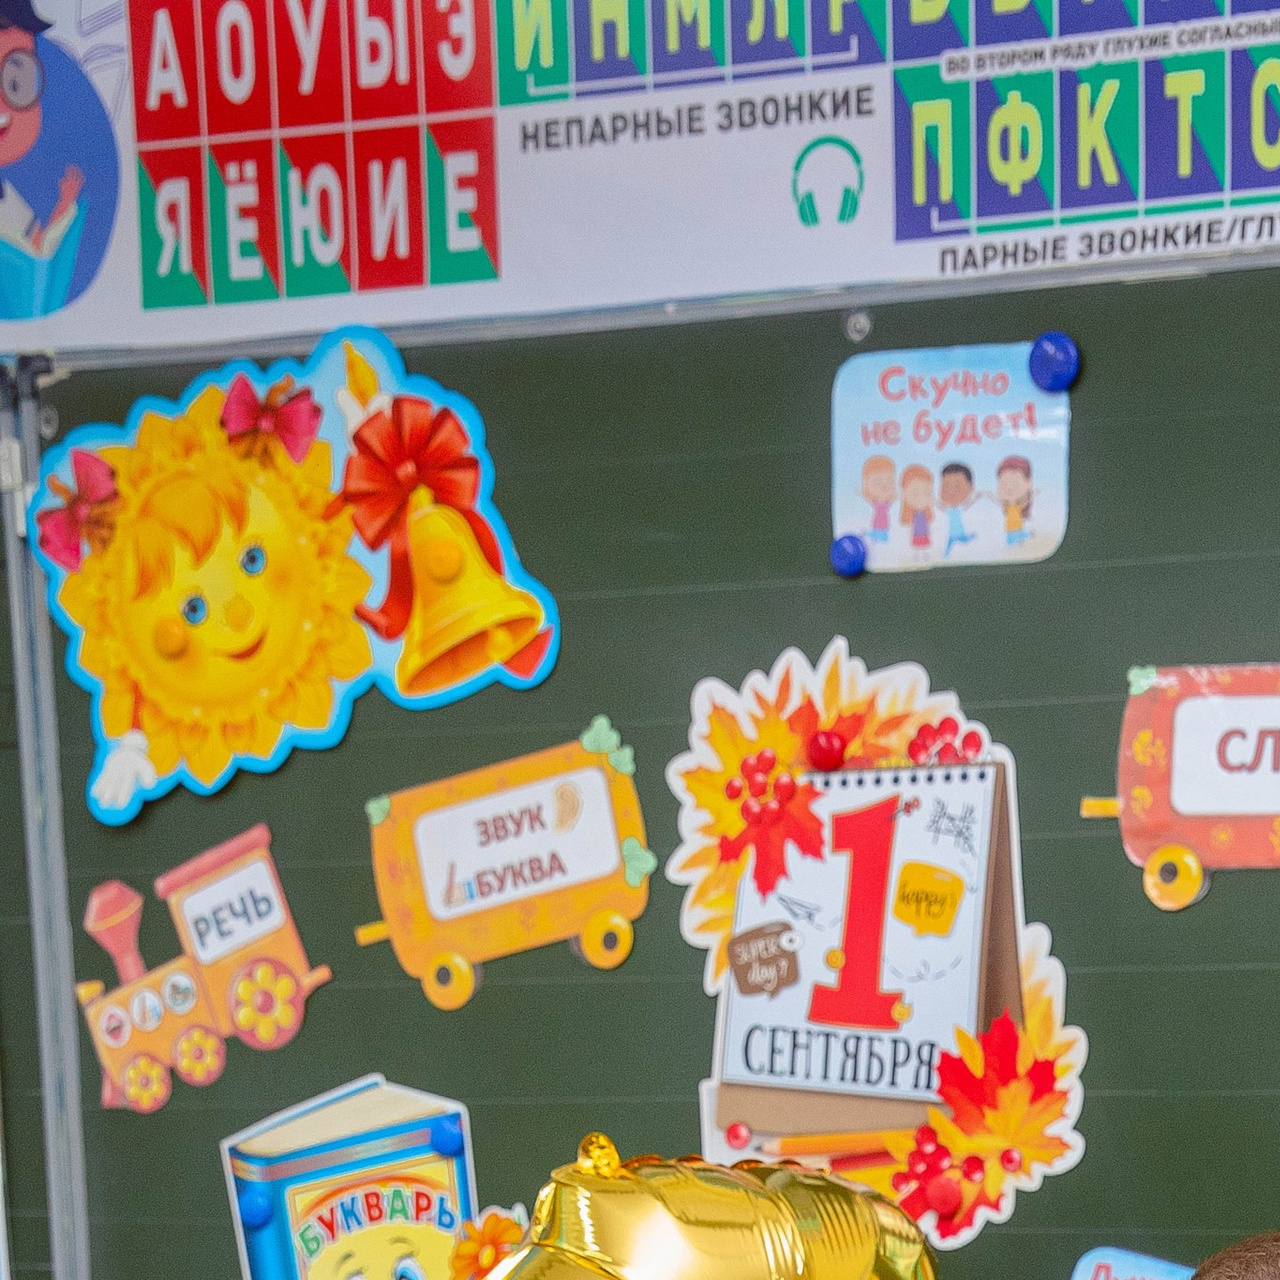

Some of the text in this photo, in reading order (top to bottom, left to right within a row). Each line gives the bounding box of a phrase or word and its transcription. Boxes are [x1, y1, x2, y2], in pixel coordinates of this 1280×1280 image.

[146, 8, 188, 111] А
[215, 2, 256, 105] О
[975, 47, 1045, 71] ВТОРОМ
[520, 84, 876, 153] НЕПАРНЫЕ ЗВОНКИЕ
[911, 98, 953, 205] П
[987, 90, 1043, 196] Ф
[1076, 78, 1120, 189] К
[1163, 69, 1206, 178] Т
[154, 150, 482, 282] Я Ё Ю И Е
[940, 234, 1068, 276] ПАРНЫЕ
[878, 365, 1009, 408] Скучно
[861, 401, 1037, 450] не будет!
[475, 806, 546, 848] ЗВУК
[475, 853, 568, 900] БУКВА
[193, 892, 274, 950] РЕЧЬ
[807, 793, 903, 1031] 1
[743, 1023, 940, 1089] СЕНТЯБРЯ
[298, 1186, 459, 1259] БУКВАРЬ
